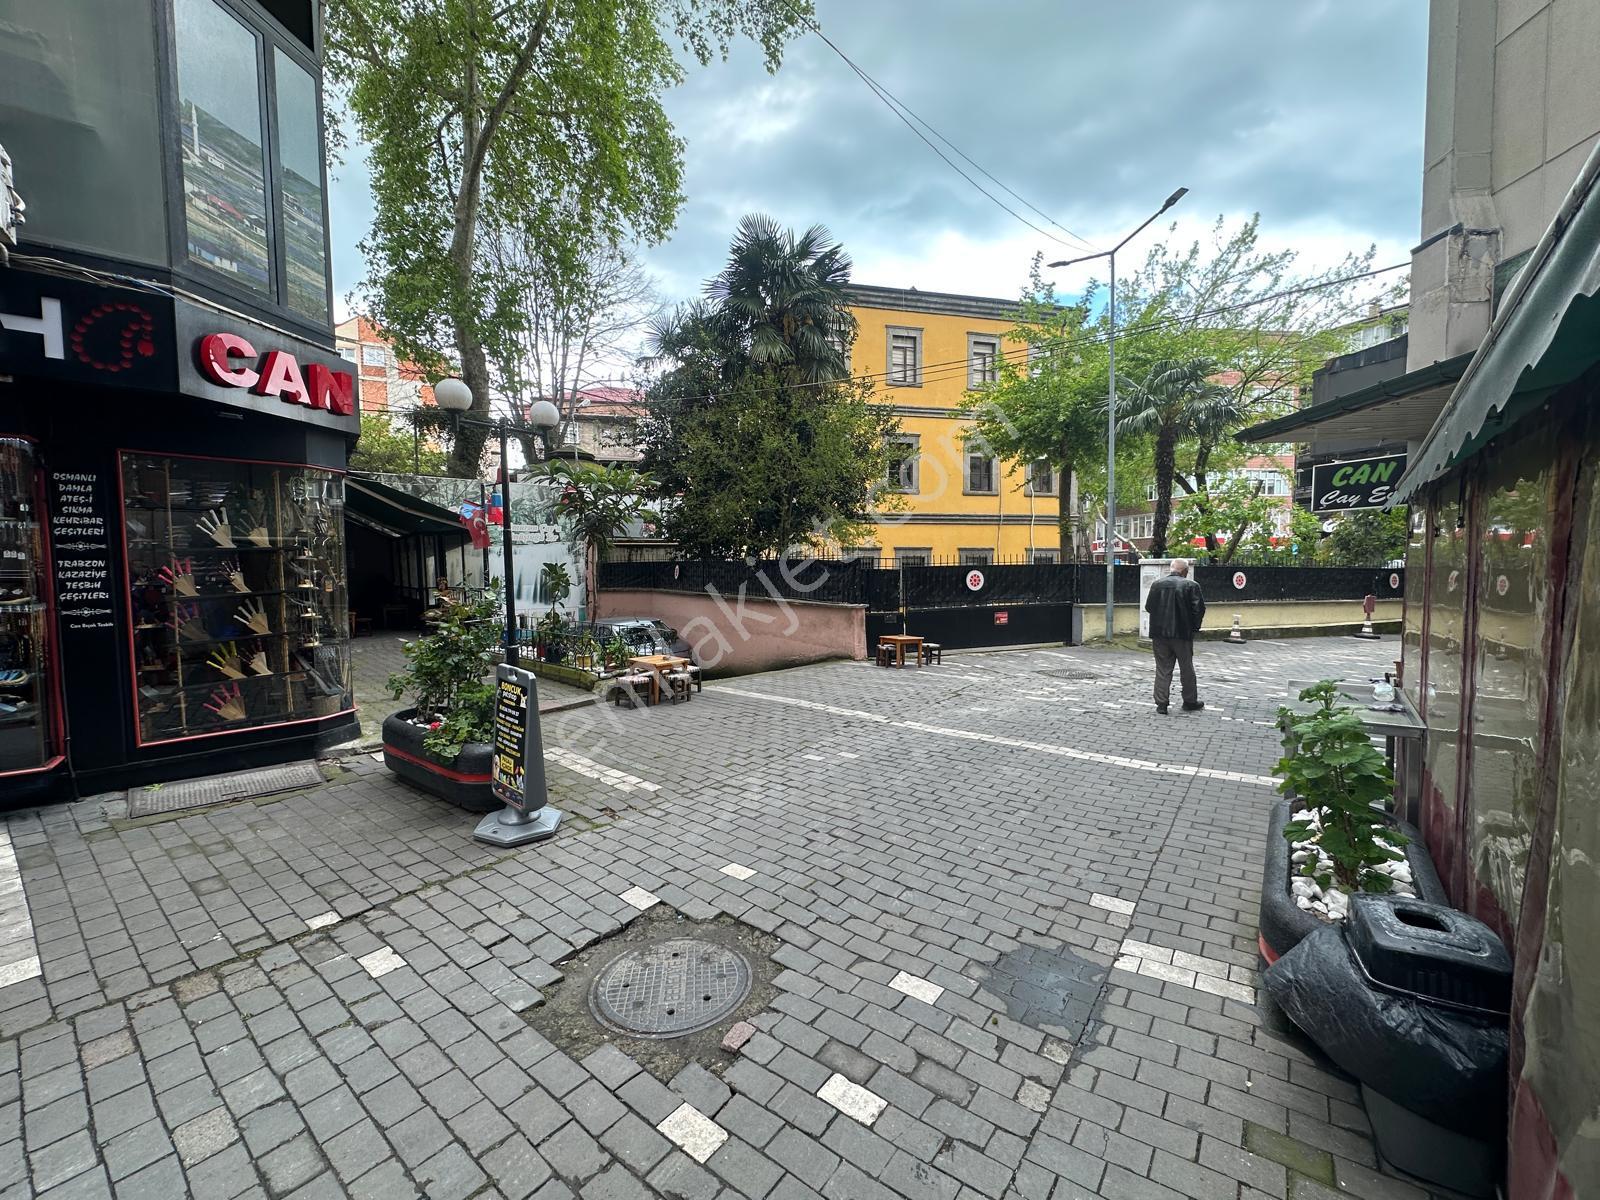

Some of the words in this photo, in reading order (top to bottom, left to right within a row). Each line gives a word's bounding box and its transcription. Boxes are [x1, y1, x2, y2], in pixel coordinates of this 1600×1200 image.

[200, 332, 354, 416] CAN
[53, 472, 97, 482] OSMANLI
[1331, 460, 1398, 488] CAN
[58, 483, 93, 493] DAMLA
[1319, 489, 1363, 510] Çay
[57, 559, 106, 568] TRABZON
[58, 568, 108, 579] KAZAZİYE
